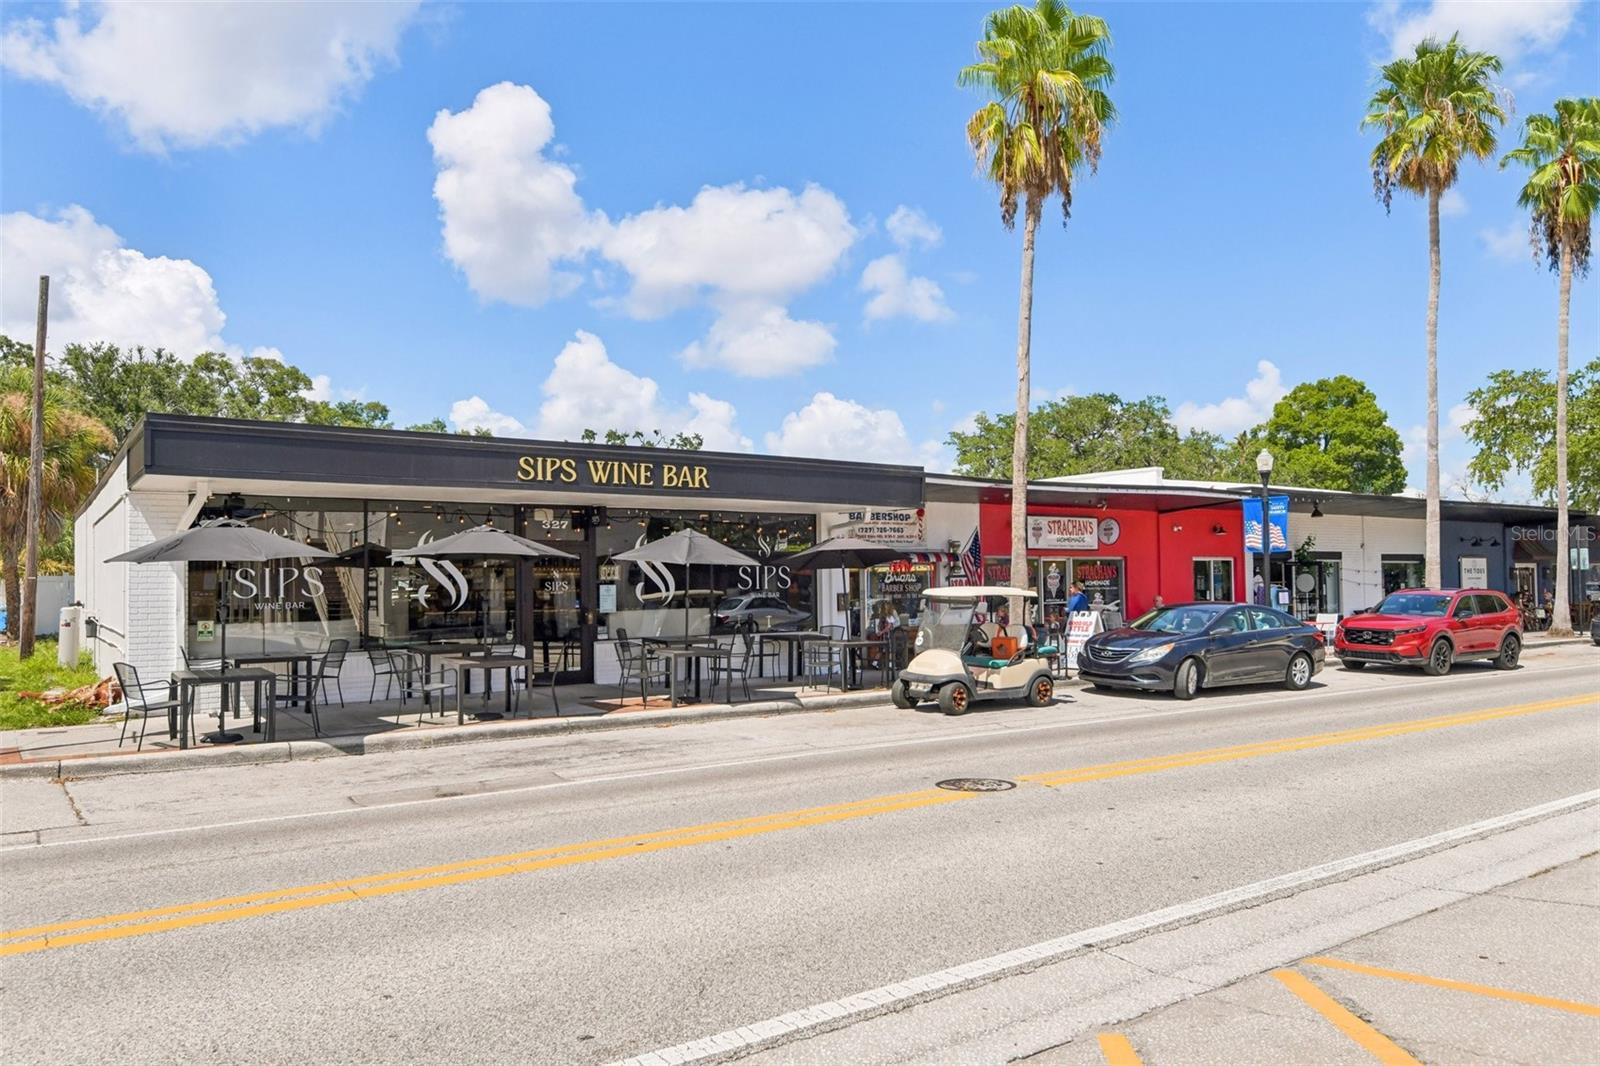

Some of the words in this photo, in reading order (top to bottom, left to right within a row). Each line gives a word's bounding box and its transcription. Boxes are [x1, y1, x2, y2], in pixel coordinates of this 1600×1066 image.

[517, 456, 577, 483] SIPS
[587, 459, 654, 487] WINE
[662, 464, 710, 489] BAR
[848, 512, 911, 522] BABERSHOP
[542, 520, 568, 529] 327
[1047, 519, 1094, 537] STRACHAN'S
[737, 565, 791, 590] SIPS
[232, 567, 325, 599] SIPS
[544, 581, 569, 591] SIPS
[881, 584, 904, 593] BARBER
[905, 583, 921, 592] SHOP
[254, 602, 281, 610] WINE
[285, 601, 305, 609] BAR
